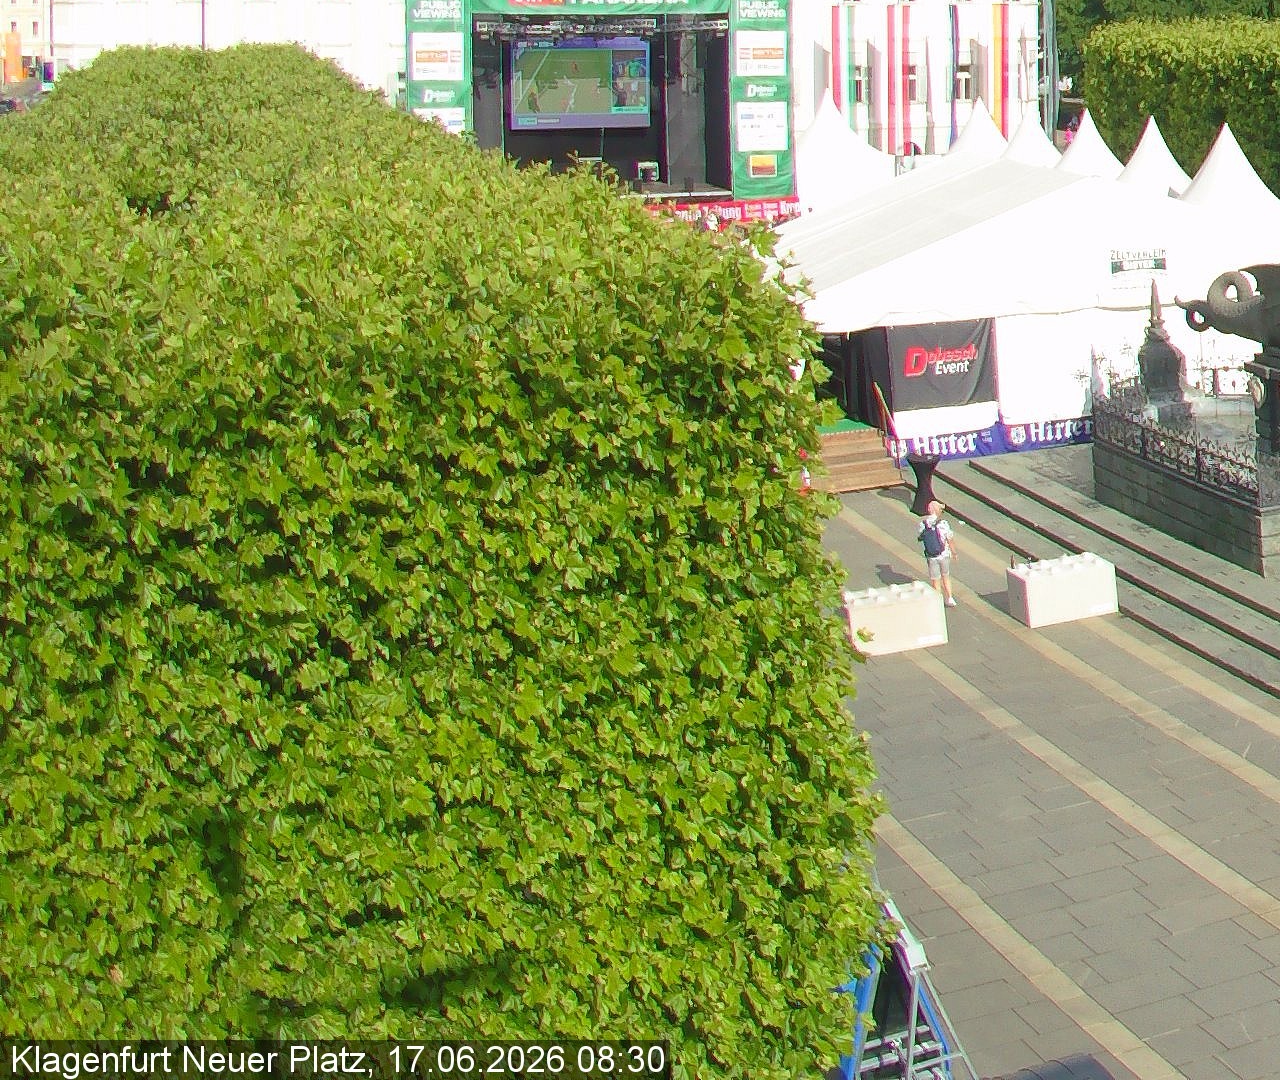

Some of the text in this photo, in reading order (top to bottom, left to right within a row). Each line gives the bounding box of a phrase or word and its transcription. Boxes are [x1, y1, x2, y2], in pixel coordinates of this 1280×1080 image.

[420, 0, 462, 9] PUBLIC
[739, 0, 779, 9] PUBLIC
[413, 9, 462, 19] VIEWING
[739, 9, 787, 18] VIEWING
[935, 360, 969, 375] Event
[1030, 418, 1092, 442] Hirter
[913, 432, 977, 455] Hirter
